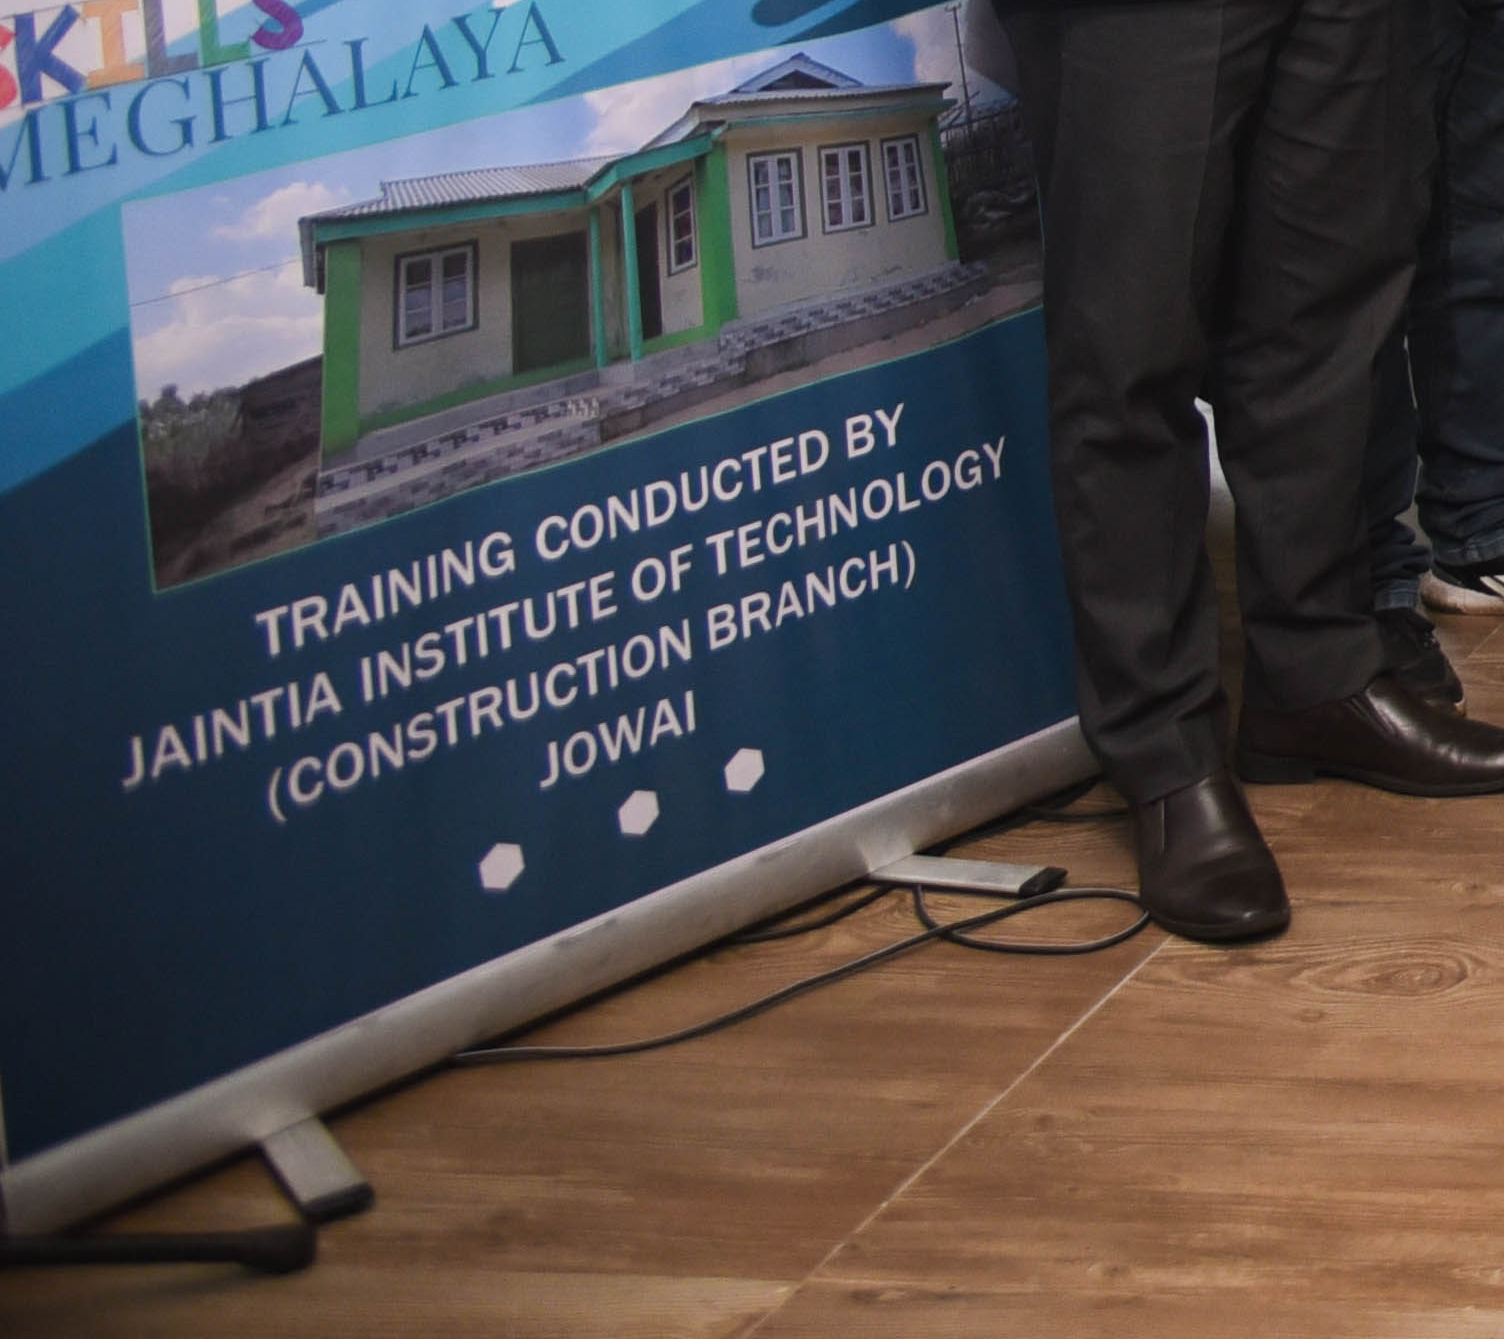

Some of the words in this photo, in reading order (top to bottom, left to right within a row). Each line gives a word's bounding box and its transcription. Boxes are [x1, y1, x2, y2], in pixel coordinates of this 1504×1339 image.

[121, 671, 343, 792] JAINTIA
[360, 571, 619, 703] INSTITUTE
[630, 543, 693, 603] OF
[705, 435, 1006, 576] TECHNOLOGY
[255, 531, 516, 658] TRAINING
[534, 428, 830, 562] CONDUCTED
[845, 403, 903, 459] BY
[267, 619, 693, 824] (CONSTRUCTION
[706, 540, 917, 652] BRANCH)
[539, 689, 697, 791] JOWAI
